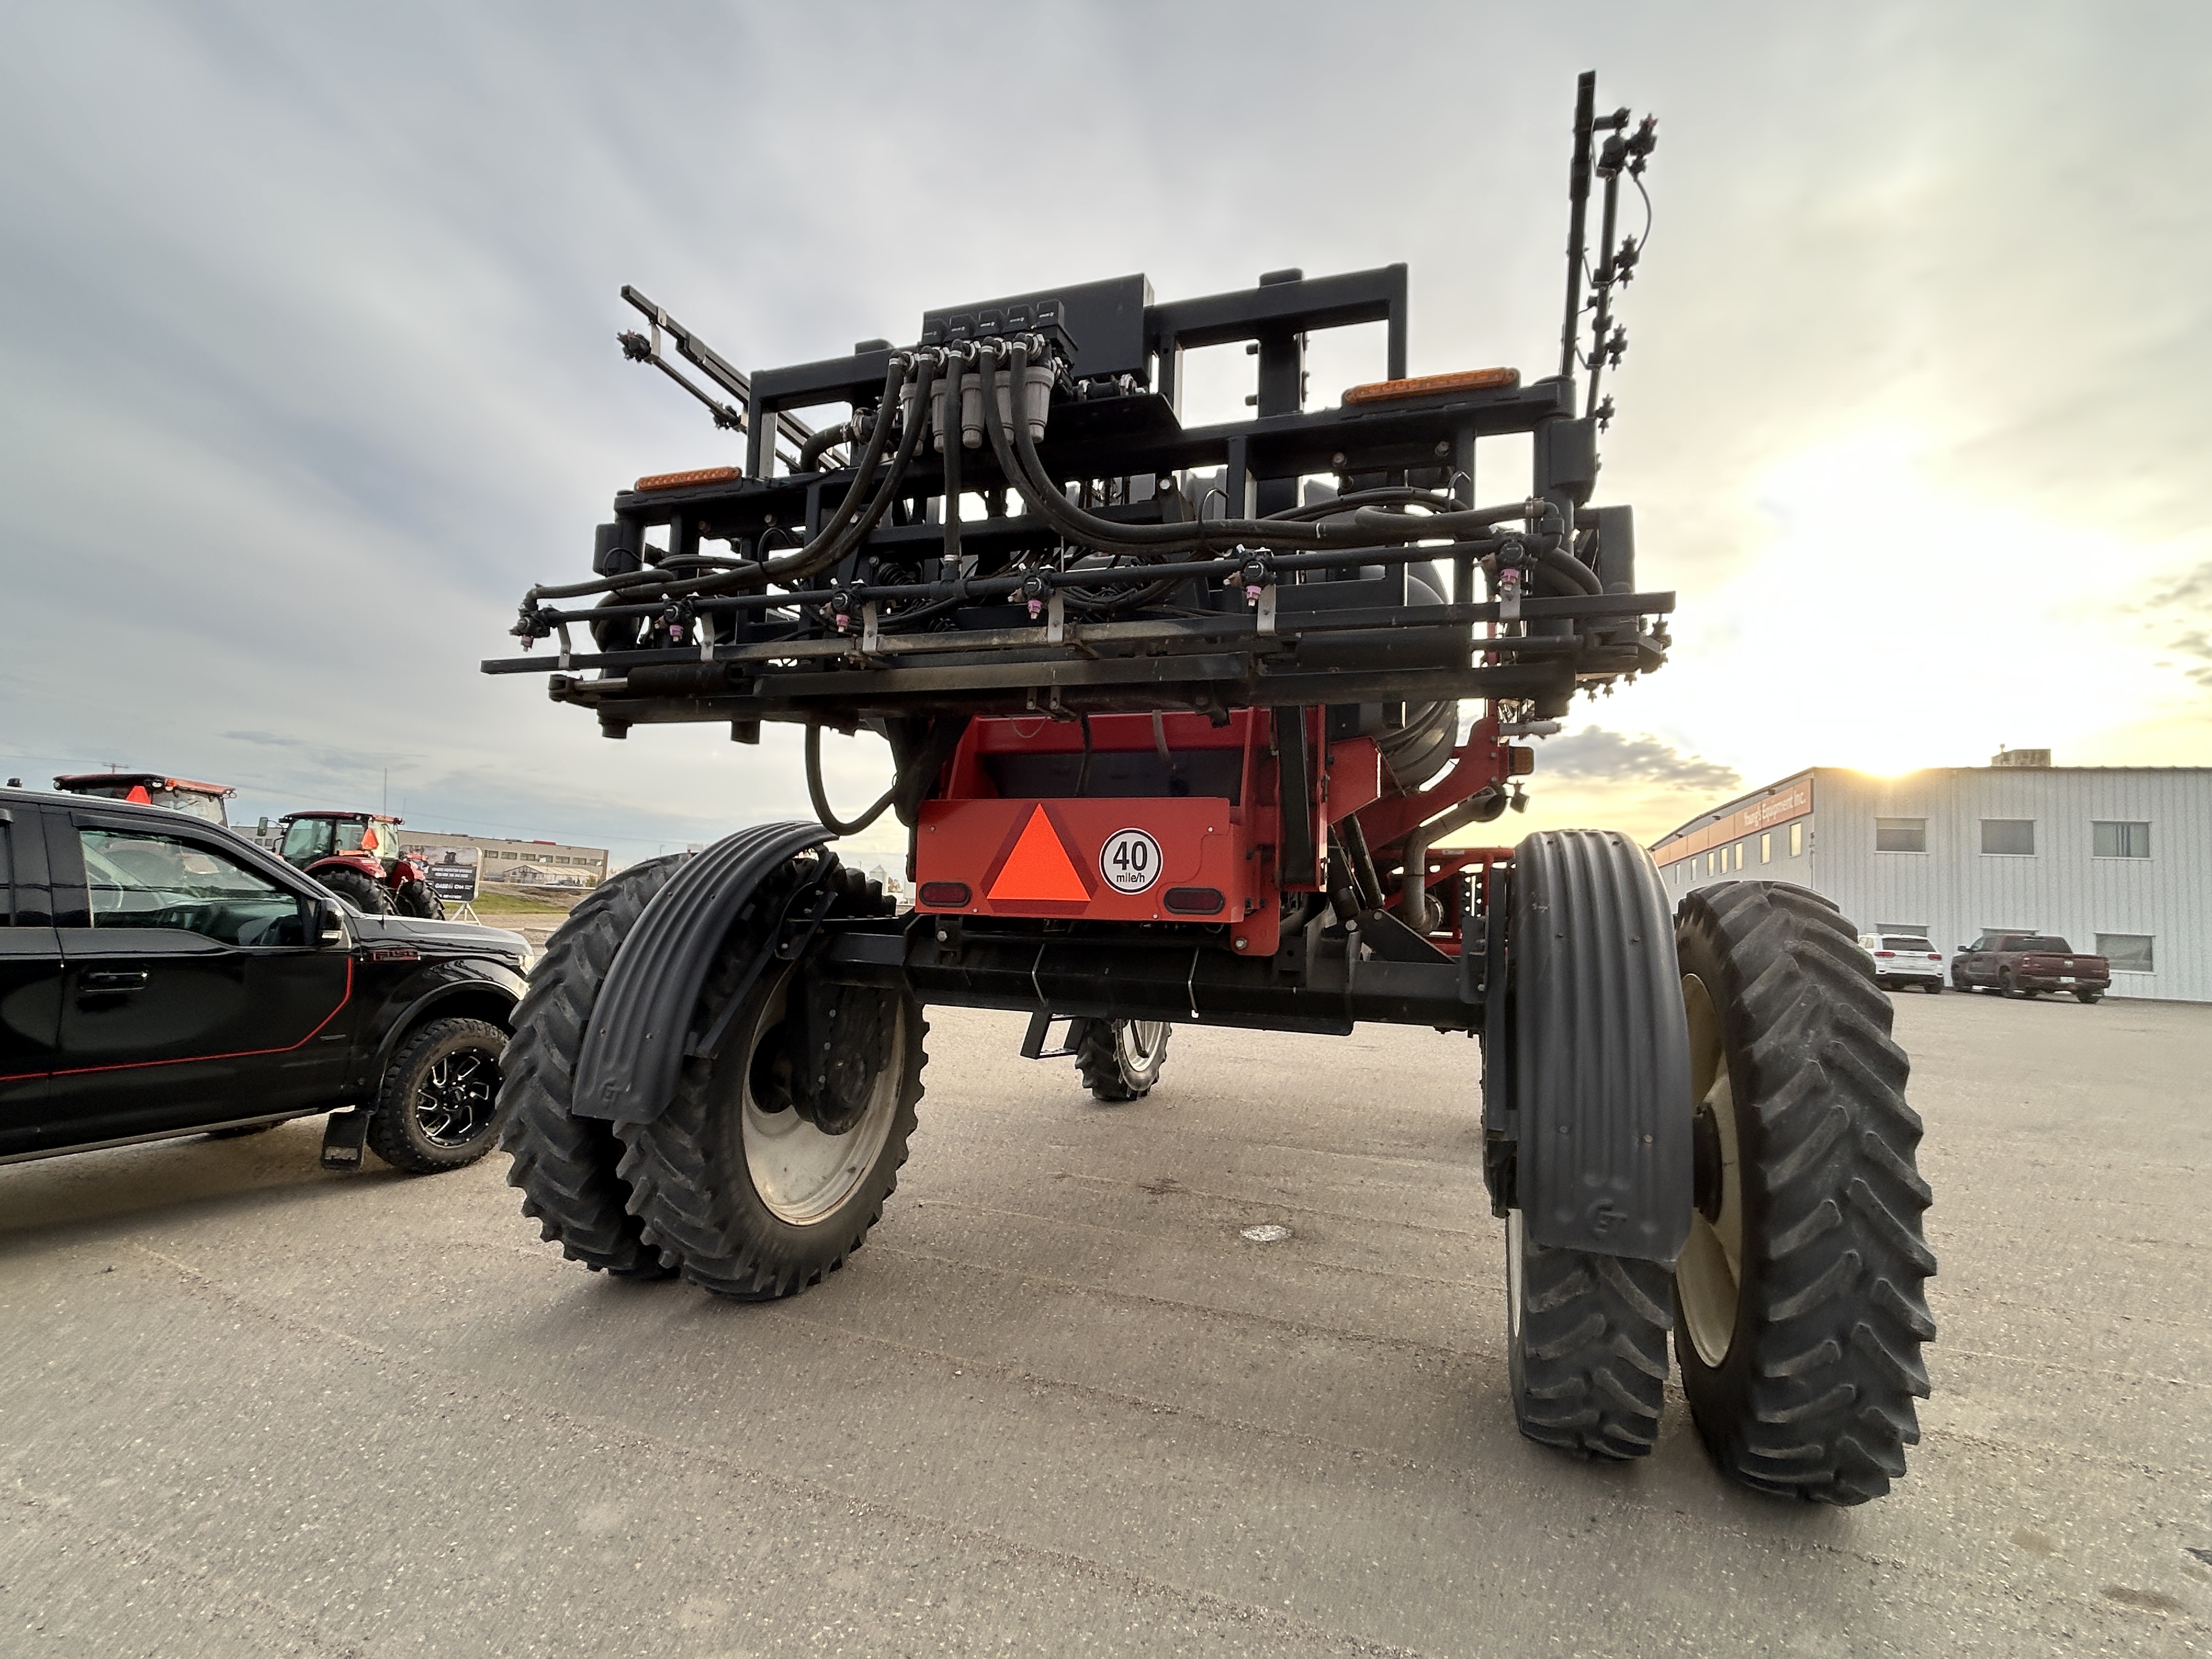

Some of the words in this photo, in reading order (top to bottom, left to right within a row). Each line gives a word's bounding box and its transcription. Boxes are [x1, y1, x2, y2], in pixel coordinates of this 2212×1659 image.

[1744, 805, 1761, 827] Young's
[1762, 795, 1793, 822] Equipment
[1793, 790, 1807, 806] Inc.
[1113, 840, 1148, 871] 40
[1116, 872, 1146, 883] mile/h
